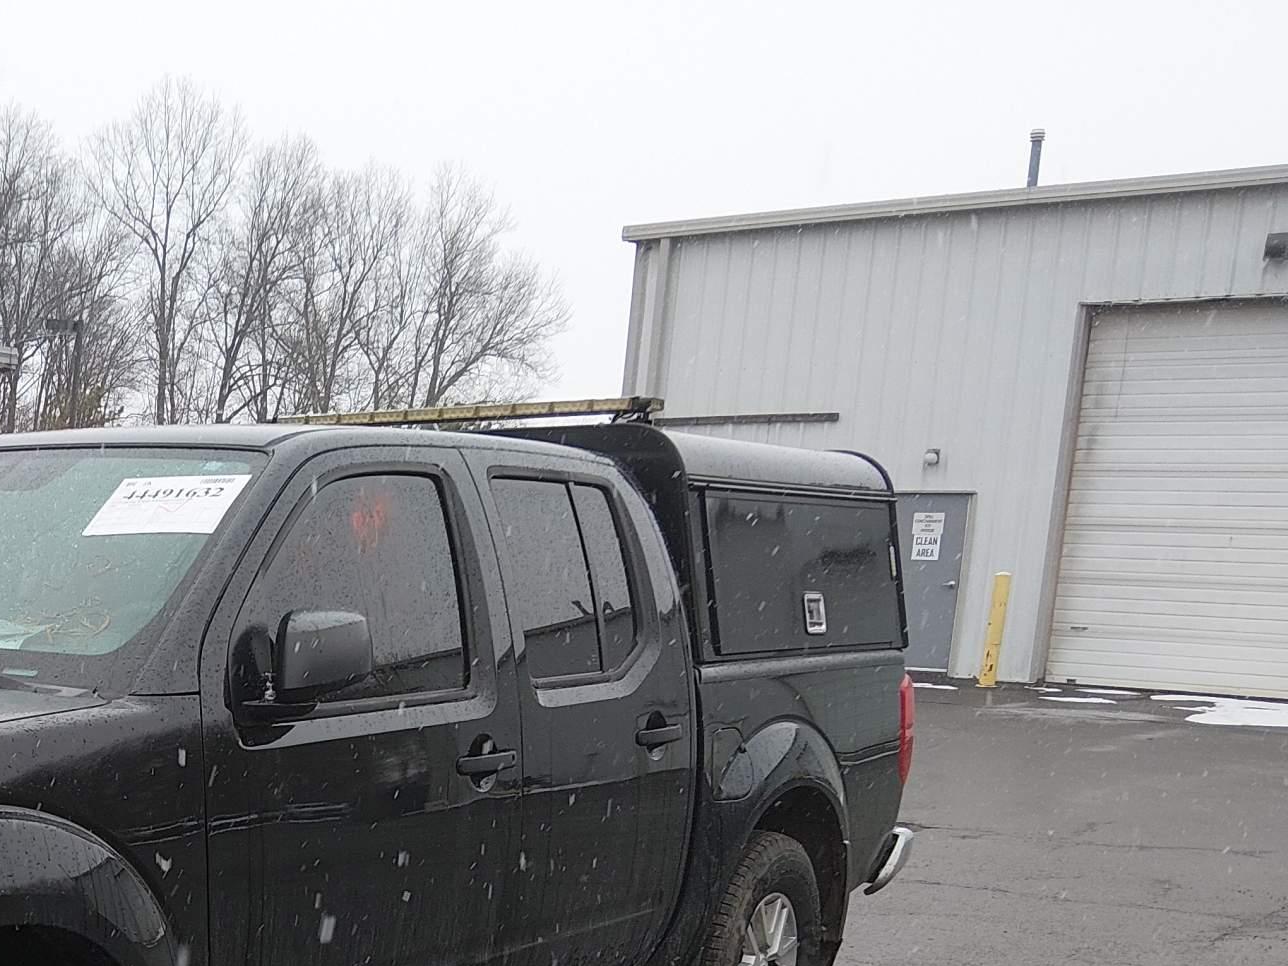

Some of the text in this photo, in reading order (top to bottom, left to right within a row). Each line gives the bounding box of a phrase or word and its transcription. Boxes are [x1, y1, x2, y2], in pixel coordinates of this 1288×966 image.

[123, 487, 225, 499] 44491632
[915, 537, 938, 546] CLEAN
[915, 548, 935, 557] AREA
